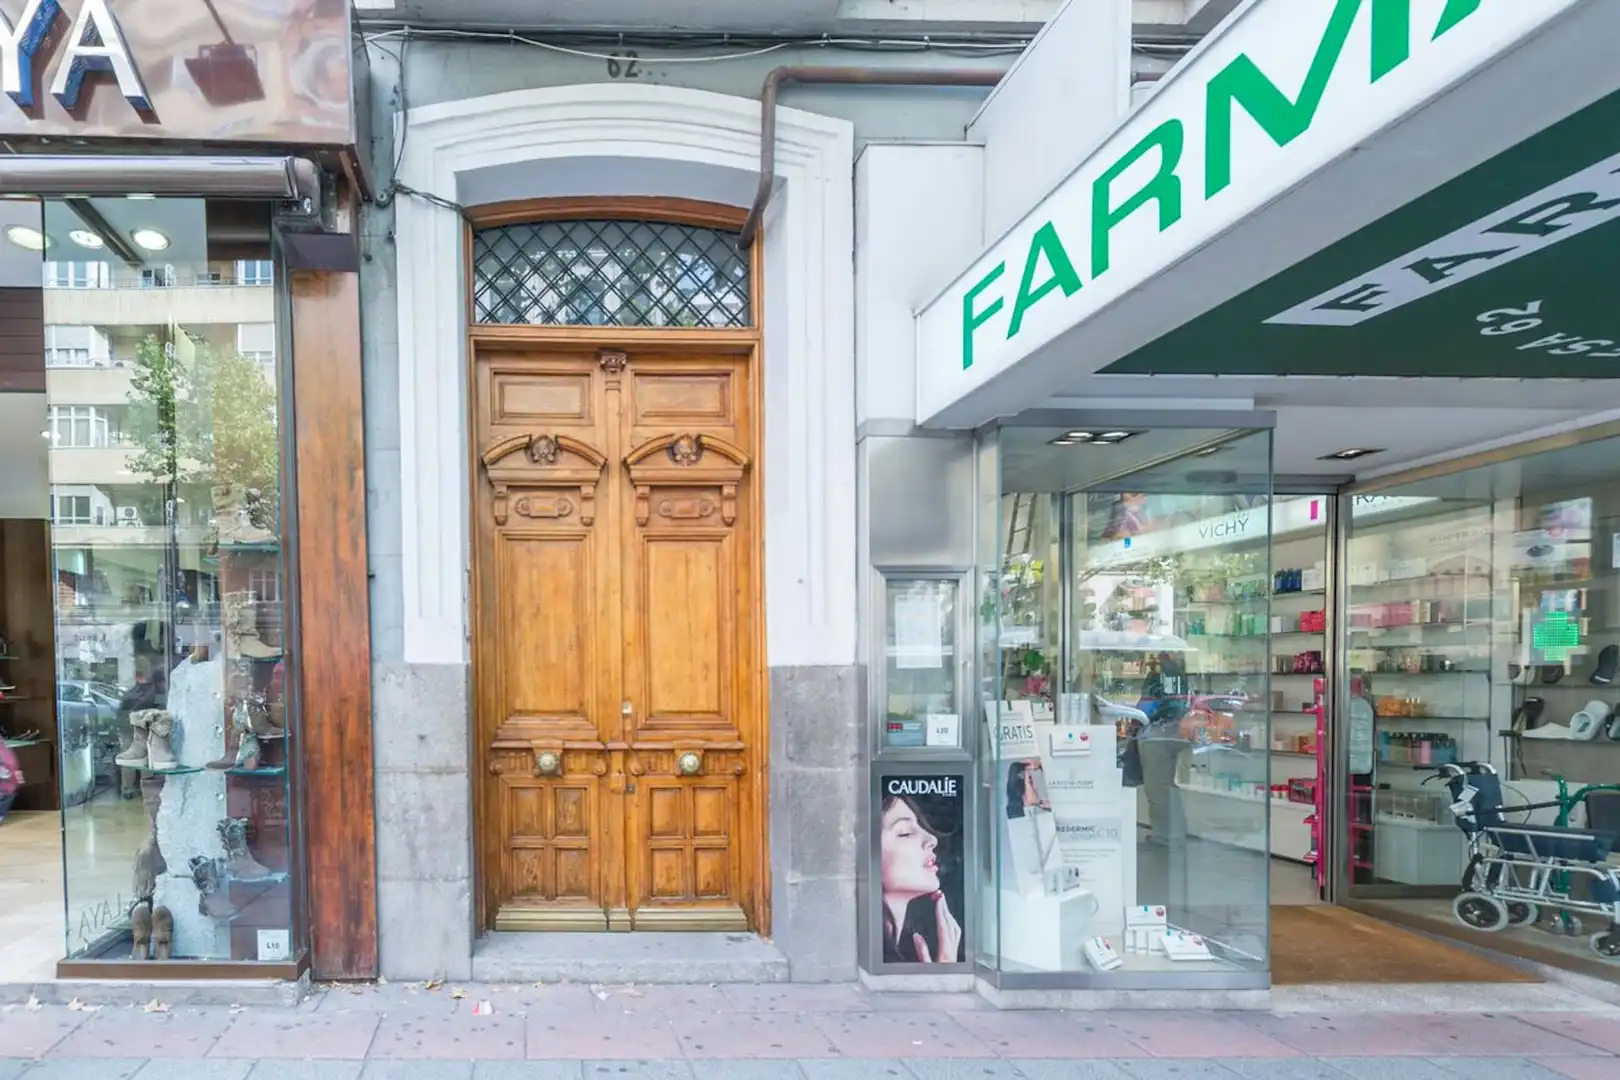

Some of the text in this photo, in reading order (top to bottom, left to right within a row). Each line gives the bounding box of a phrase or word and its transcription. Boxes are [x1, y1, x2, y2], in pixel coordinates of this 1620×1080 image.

[607, 50, 638, 79] 62
[1311, 168, 1620, 313] FAR
[1198, 517, 1250, 539] VICHY
